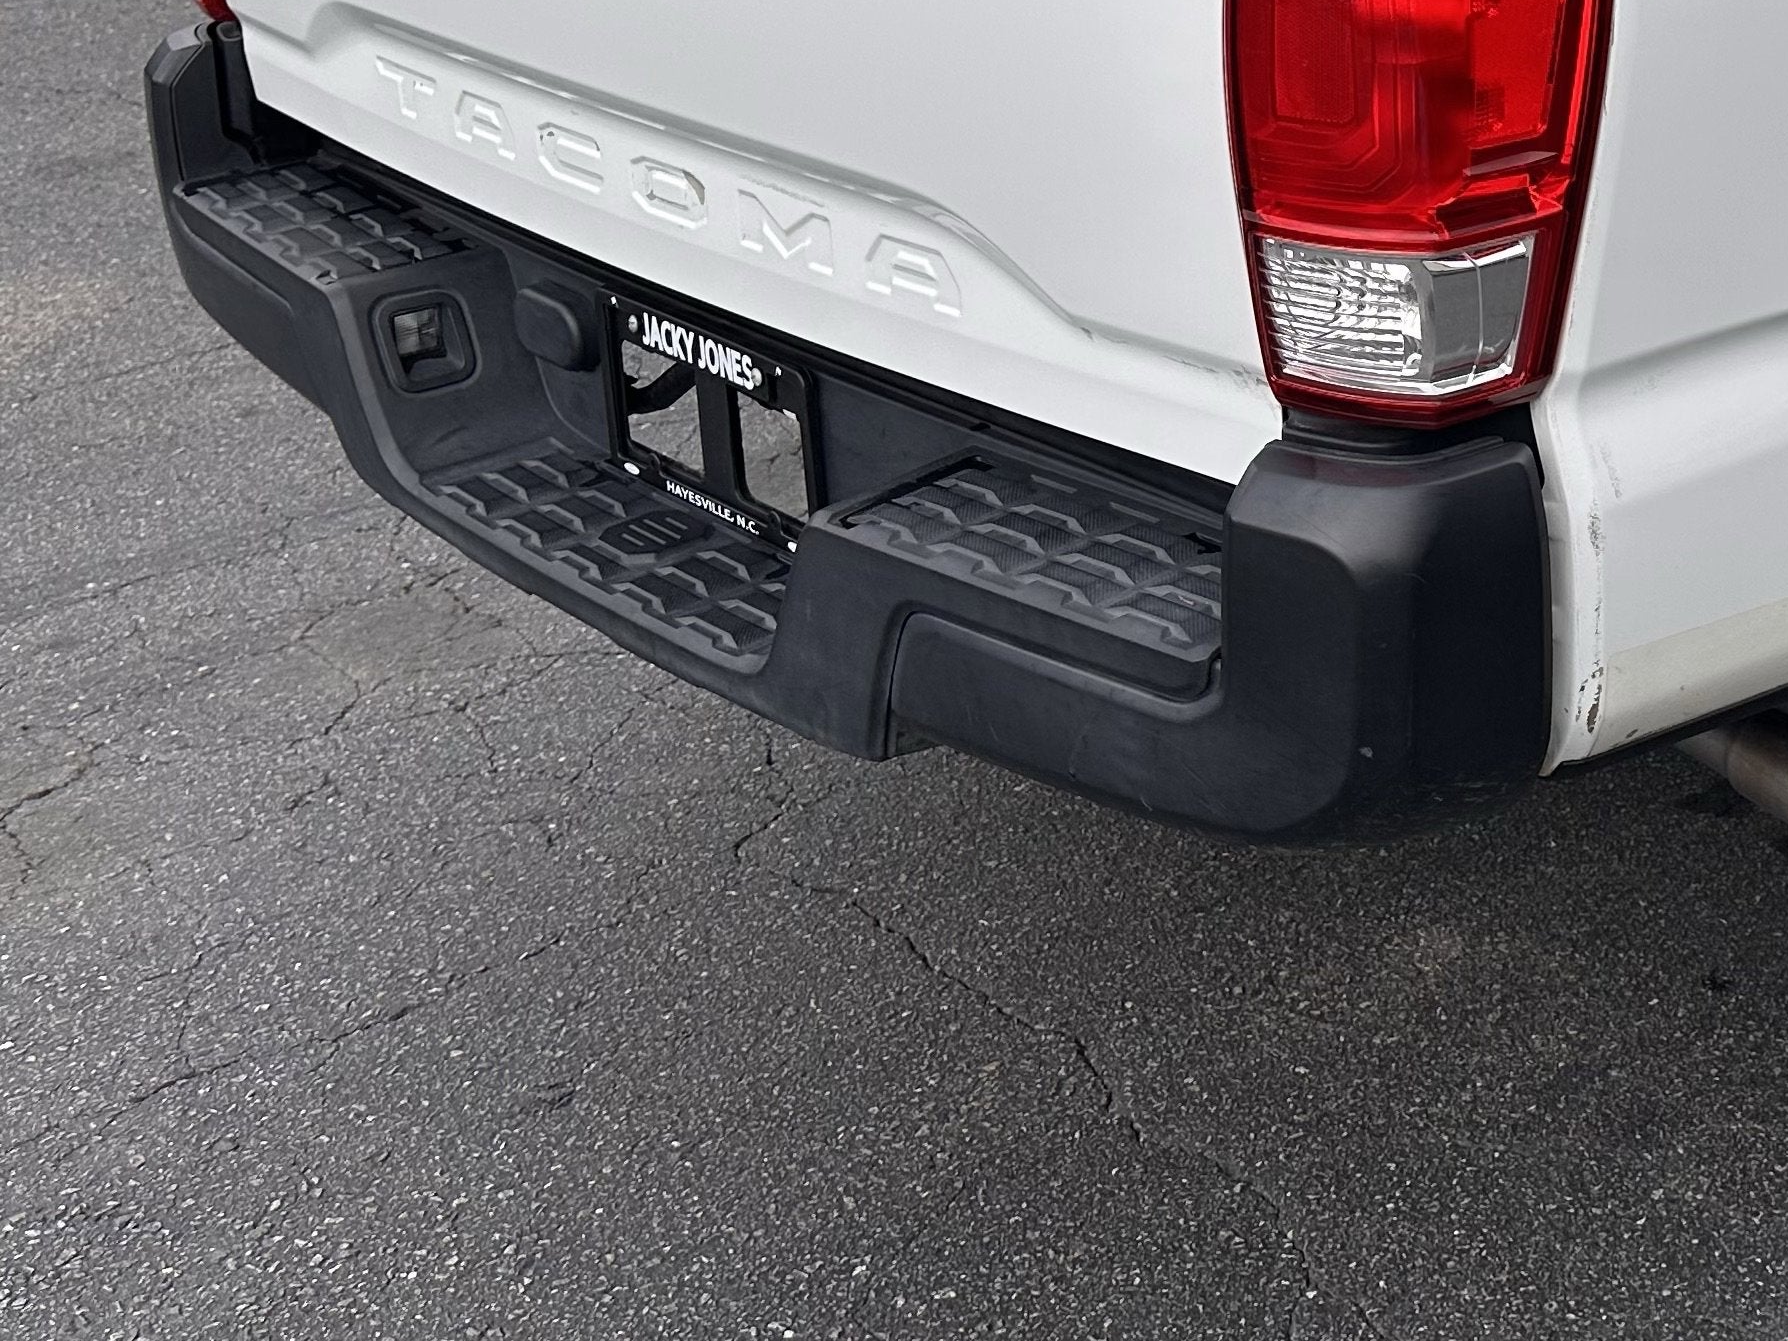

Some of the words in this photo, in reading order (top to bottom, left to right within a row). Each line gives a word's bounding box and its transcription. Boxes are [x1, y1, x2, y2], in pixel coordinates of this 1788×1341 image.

[374, 54, 963, 317] TACOMA
[642, 312, 695, 364] JACKY
[697, 334, 755, 391] JONES
[736, 514, 760, 536] N.C.
